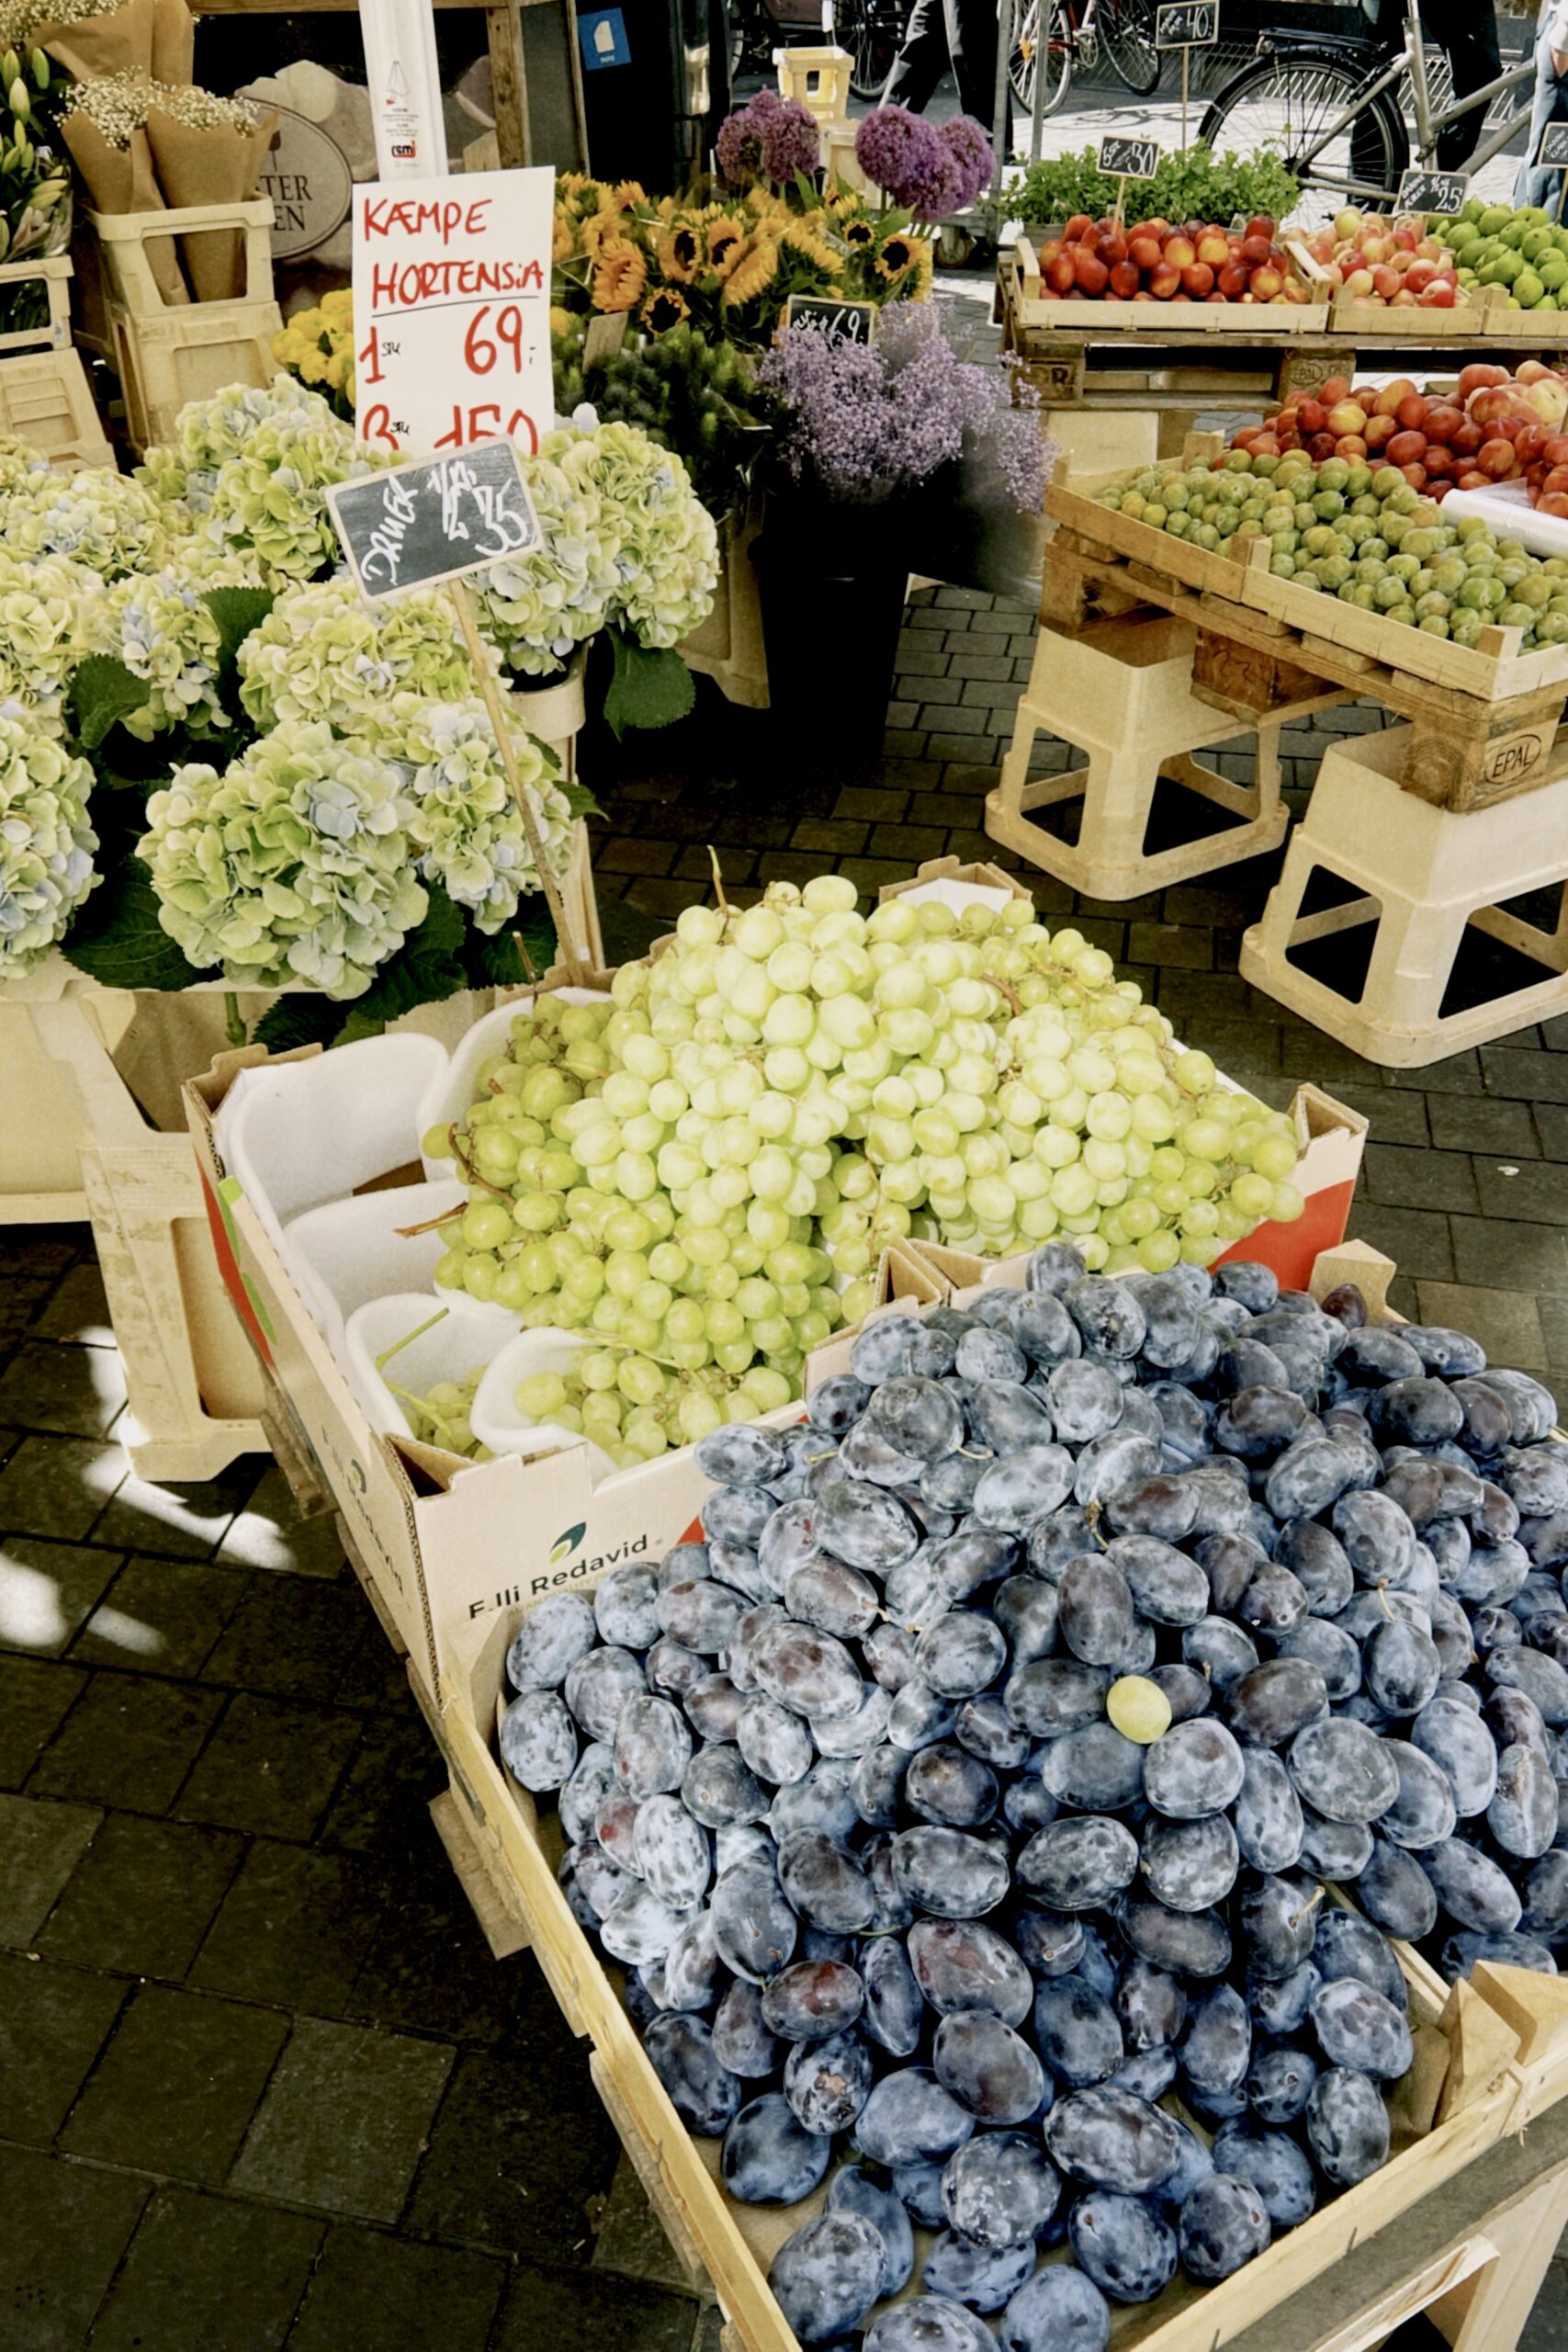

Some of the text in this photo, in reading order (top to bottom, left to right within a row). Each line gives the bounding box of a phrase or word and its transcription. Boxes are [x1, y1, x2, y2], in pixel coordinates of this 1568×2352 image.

[255, 175, 313, 201] TER
[1434, 187, 1463, 212] 25
[364, 198, 492, 245] KÆMPE
[472, 478, 529, 558] 35
[1492, 742, 1531, 778] EPAL
